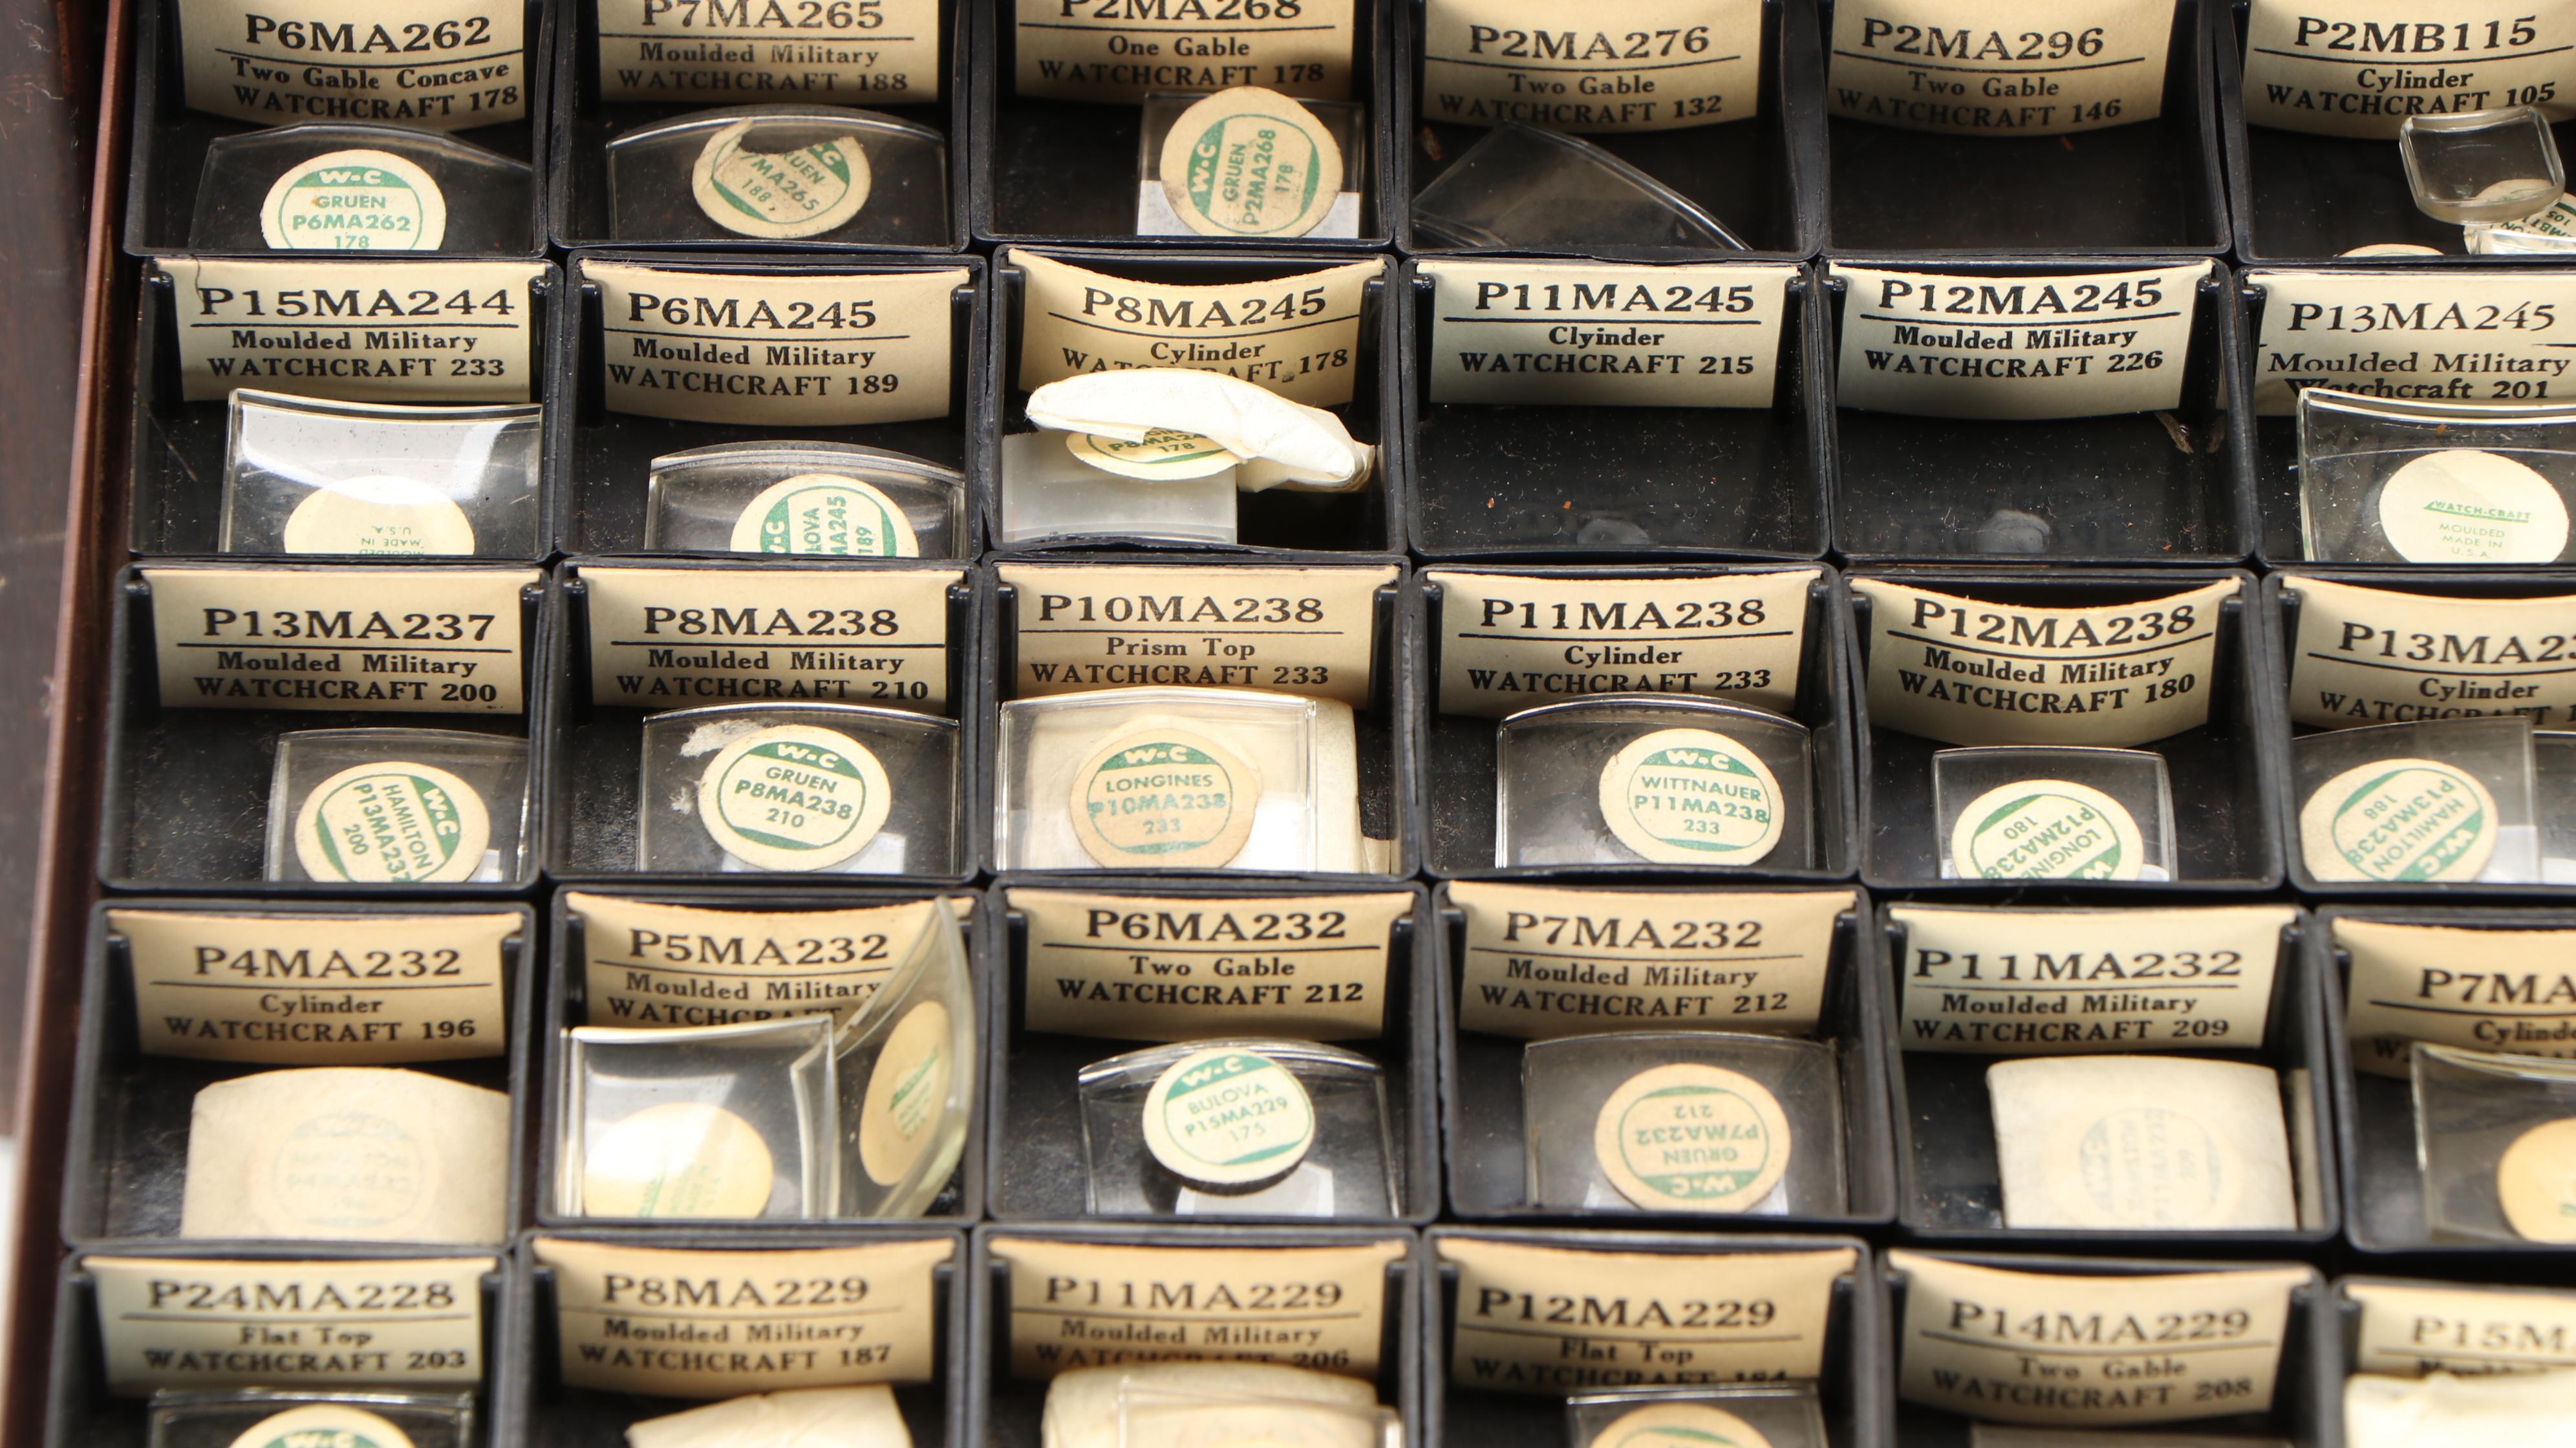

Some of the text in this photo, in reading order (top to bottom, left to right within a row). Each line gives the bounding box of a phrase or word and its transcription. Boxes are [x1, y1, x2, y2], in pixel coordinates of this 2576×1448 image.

[642, 0, 885, 29] P7MA265
[1060, 0, 1302, 20] P2MA268
[246, 14, 491, 53] P6MA262
[1108, 36, 1250, 57] One Gable
[1469, 25, 1709, 59] P2MA276
[1862, 17, 2104, 61] P2MA296
[2294, 15, 2536, 53] P2MB115
[639, 42, 879, 67] Moulded Military
[231, 56, 509, 90] Two Gable Concave
[618, 69, 908, 91] WATCHCRAFT 188
[1039, 60, 1325, 86] WATCHCRAFT 178
[1508, 72, 1655, 94] Two Gable
[1908, 70, 2059, 98] Two Gable
[2357, 68, 2474, 92] Cylinder
[233, 85, 518, 118] WATCHCRAFT 178
[1439, 94, 1722, 123] WATCHCRAFT 132
[1838, 87, 2121, 127] WATCHCRAFT 146
[2266, 82, 2556, 115] WATCHCRAFT 105
[1223, 144, 1246, 201] GRUEN
[1243, 129, 1276, 226] P2MA268
[1275, 164, 1294, 192] 178
[314, 195, 386, 209] GRUEN
[742, 178, 772, 202] 188
[292, 214, 411, 232] P6MA262
[334, 234, 370, 250] 178
[199, 288, 515, 317] P15MA244
[1082, 286, 1326, 328] P8MA245
[1476, 282, 1754, 313] P11MA245
[1878, 277, 2162, 315] P12MA245
[628, 293, 877, 329] P6MA245
[2287, 301, 2555, 333] P13MA245
[231, 330, 478, 352] Moulded Military
[1549, 326, 1665, 349] Clyinder
[1893, 325, 2138, 350] Moulded Military
[632, 338, 876, 368] Moulded Military
[1150, 342, 1265, 365] Cylinder
[1298, 348, 1349, 375] 178
[1459, 352, 1754, 374] WATCHCRAFT 215
[1865, 350, 2163, 378] WATCHCRAFT 226
[2268, 352, 2570, 377] Moulded Military
[208, 358, 505, 376] WATCHCRAFT 233
[608, 363, 899, 396] WATCHCRAFT 189
[2492, 381, 2549, 398] 201
[1158, 443, 1195, 452] 178
[855, 525, 874, 553] 189
[2439, 522, 2506, 538] MOULDED
[2442, 535, 2502, 548] MADE IN
[645, 607, 899, 637] P8MA238
[1039, 594, 1325, 623] P10MA238
[1481, 599, 1766, 630] P11MA238
[203, 608, 496, 641] P13MA237
[1911, 598, 2195, 648] P12MA238
[648, 649, 904, 674] Moulded Military
[1106, 637, 1256, 660] Prism Top
[1564, 646, 1682, 668] Cylinder
[218, 651, 477, 677] Moulded Military
[1031, 663, 1329, 685] WATCHCRAFT 233
[1924, 646, 2174, 684] Moulded Military
[194, 677, 497, 702] WATCHCRAFT 200
[616, 676, 928, 700] WATCHCRAFT 210
[1468, 669, 1771, 693] WATCHCRAFT 233
[1898, 669, 2195, 714] WATCHCRAFT 180
[2420, 678, 2539, 701] Cylinder
[765, 766, 837, 793] GRUEN
[1106, 774, 1213, 792] LONGINES
[1642, 775, 1761, 802] WITTNAUER
[734, 779, 852, 820] P8MA238
[1088, 793, 1227, 817] P10MA238
[1634, 795, 1769, 824] P11MA238
[2364, 794, 2398, 819] 188
[381, 783, 433, 869] HAMILTON
[765, 808, 804, 828] 210
[1142, 819, 1181, 835] 233
[1683, 819, 1720, 835] 233
[2003, 816, 2038, 840] 180
[2347, 778, 2456, 863] P13MA238
[343, 824, 369, 855] 200
[2374, 798, 2465, 873] HAMILTON
[1086, 910, 1346, 942] P6MA232
[1503, 911, 1763, 949] P7MA232
[628, 928, 889, 966] P5MA232
[194, 946, 461, 979] P4MA232
[1129, 955, 1296, 977] Two Gable
[1506, 959, 1757, 988] Moulded Military
[1913, 949, 2242, 981] P11MA232
[626, 972, 882, 1001] Moulded Military
[1056, 979, 1363, 1005] WATCHCRAFT 212
[260, 994, 384, 1017] Cylinder
[1480, 985, 1788, 1016] WATCHCRAFT 212
[1942, 994, 2198, 1014] Moulded Military
[164, 1017, 476, 1041] WATCHCRAFT 196
[1913, 1019, 2229, 1042] WATCHCRAFT 209
[1187, 1083, 1268, 1115] BULOVA
[1673, 1104, 1713, 1119] 212
[1185, 1096, 1288, 1138] P15MA229
[1228, 1122, 1266, 1144] 175
[1636, 1123, 1759, 1145] P7MA232
[1663, 1147, 1737, 1164] GRUEN
[147, 1279, 455, 1310] P24MA228
[603, 1274, 870, 1307] P8MA229
[1046, 1277, 1344, 1310] P11MA229
[1477, 1287, 1776, 1327] P12MA229
[604, 1319, 864, 1343] Moulded Military
[1061, 1319, 1323, 1345] Moulded Military
[1949, 1299, 2249, 1344] P14MA229
[239, 1326, 373, 1348] Flat Top
[143, 1350, 466, 1372] WATCHCRAFT 203
[579, 1344, 892, 1372] WATCHCRAFT 187
[1560, 1338, 1693, 1364] Flat Top
[2017, 1358, 2187, 1379] Two Gable
[1933, 1369, 2175, 1409] WATCHCRAFT
